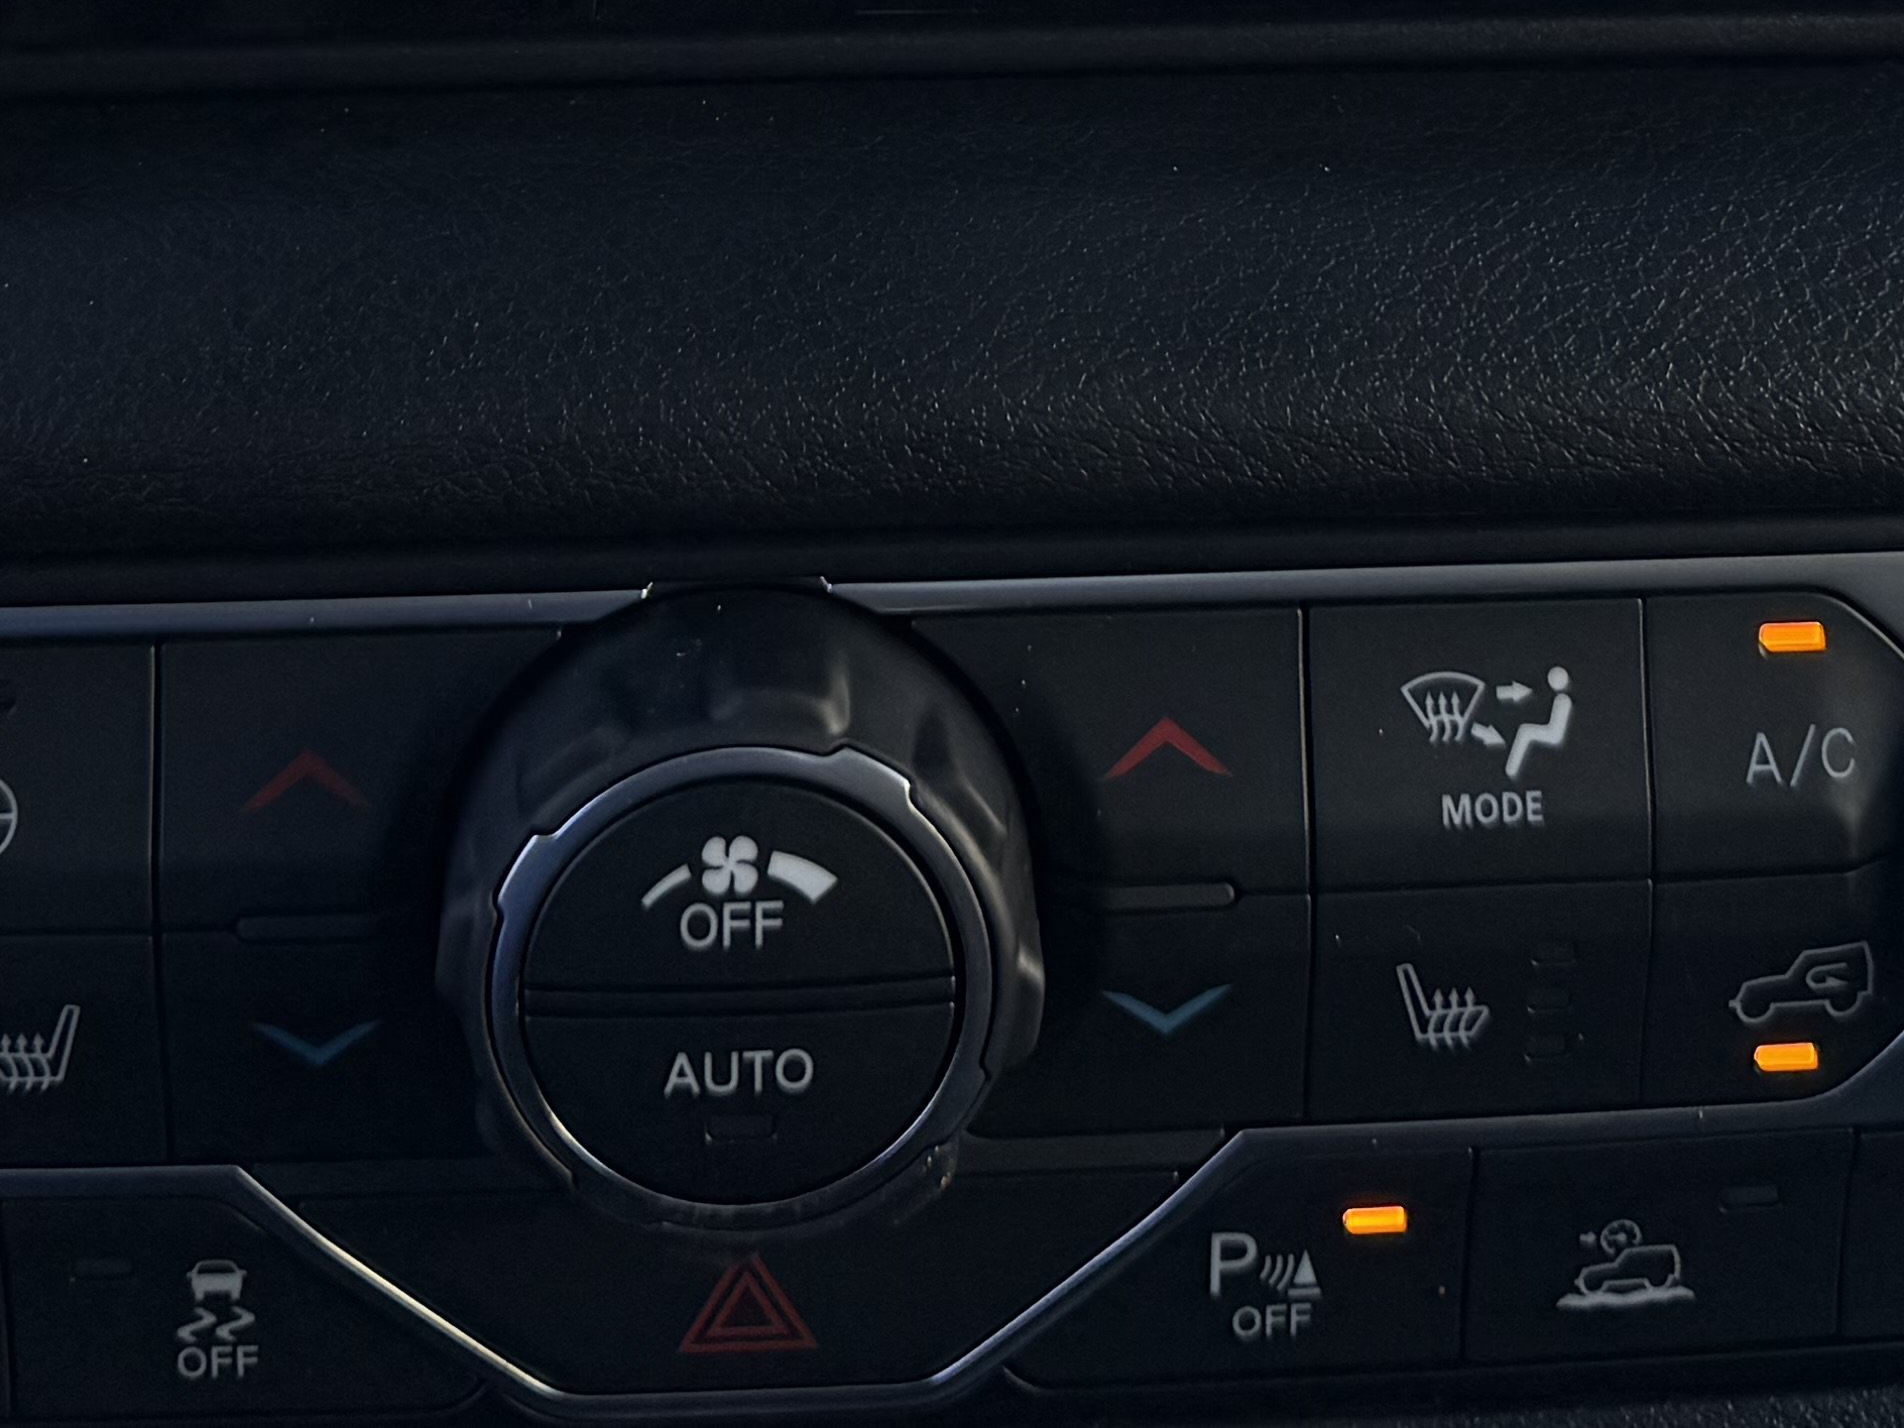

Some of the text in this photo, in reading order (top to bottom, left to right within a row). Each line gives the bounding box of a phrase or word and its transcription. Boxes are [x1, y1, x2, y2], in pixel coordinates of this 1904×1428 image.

[1746, 724, 1856, 787] A/C
[1441, 791, 1543, 830] MODE
[680, 900, 784, 949] OFF
[664, 1048, 815, 1098] AUTO
[1232, 1305, 1312, 1338] OFF
[177, 1346, 258, 1379] OFF
